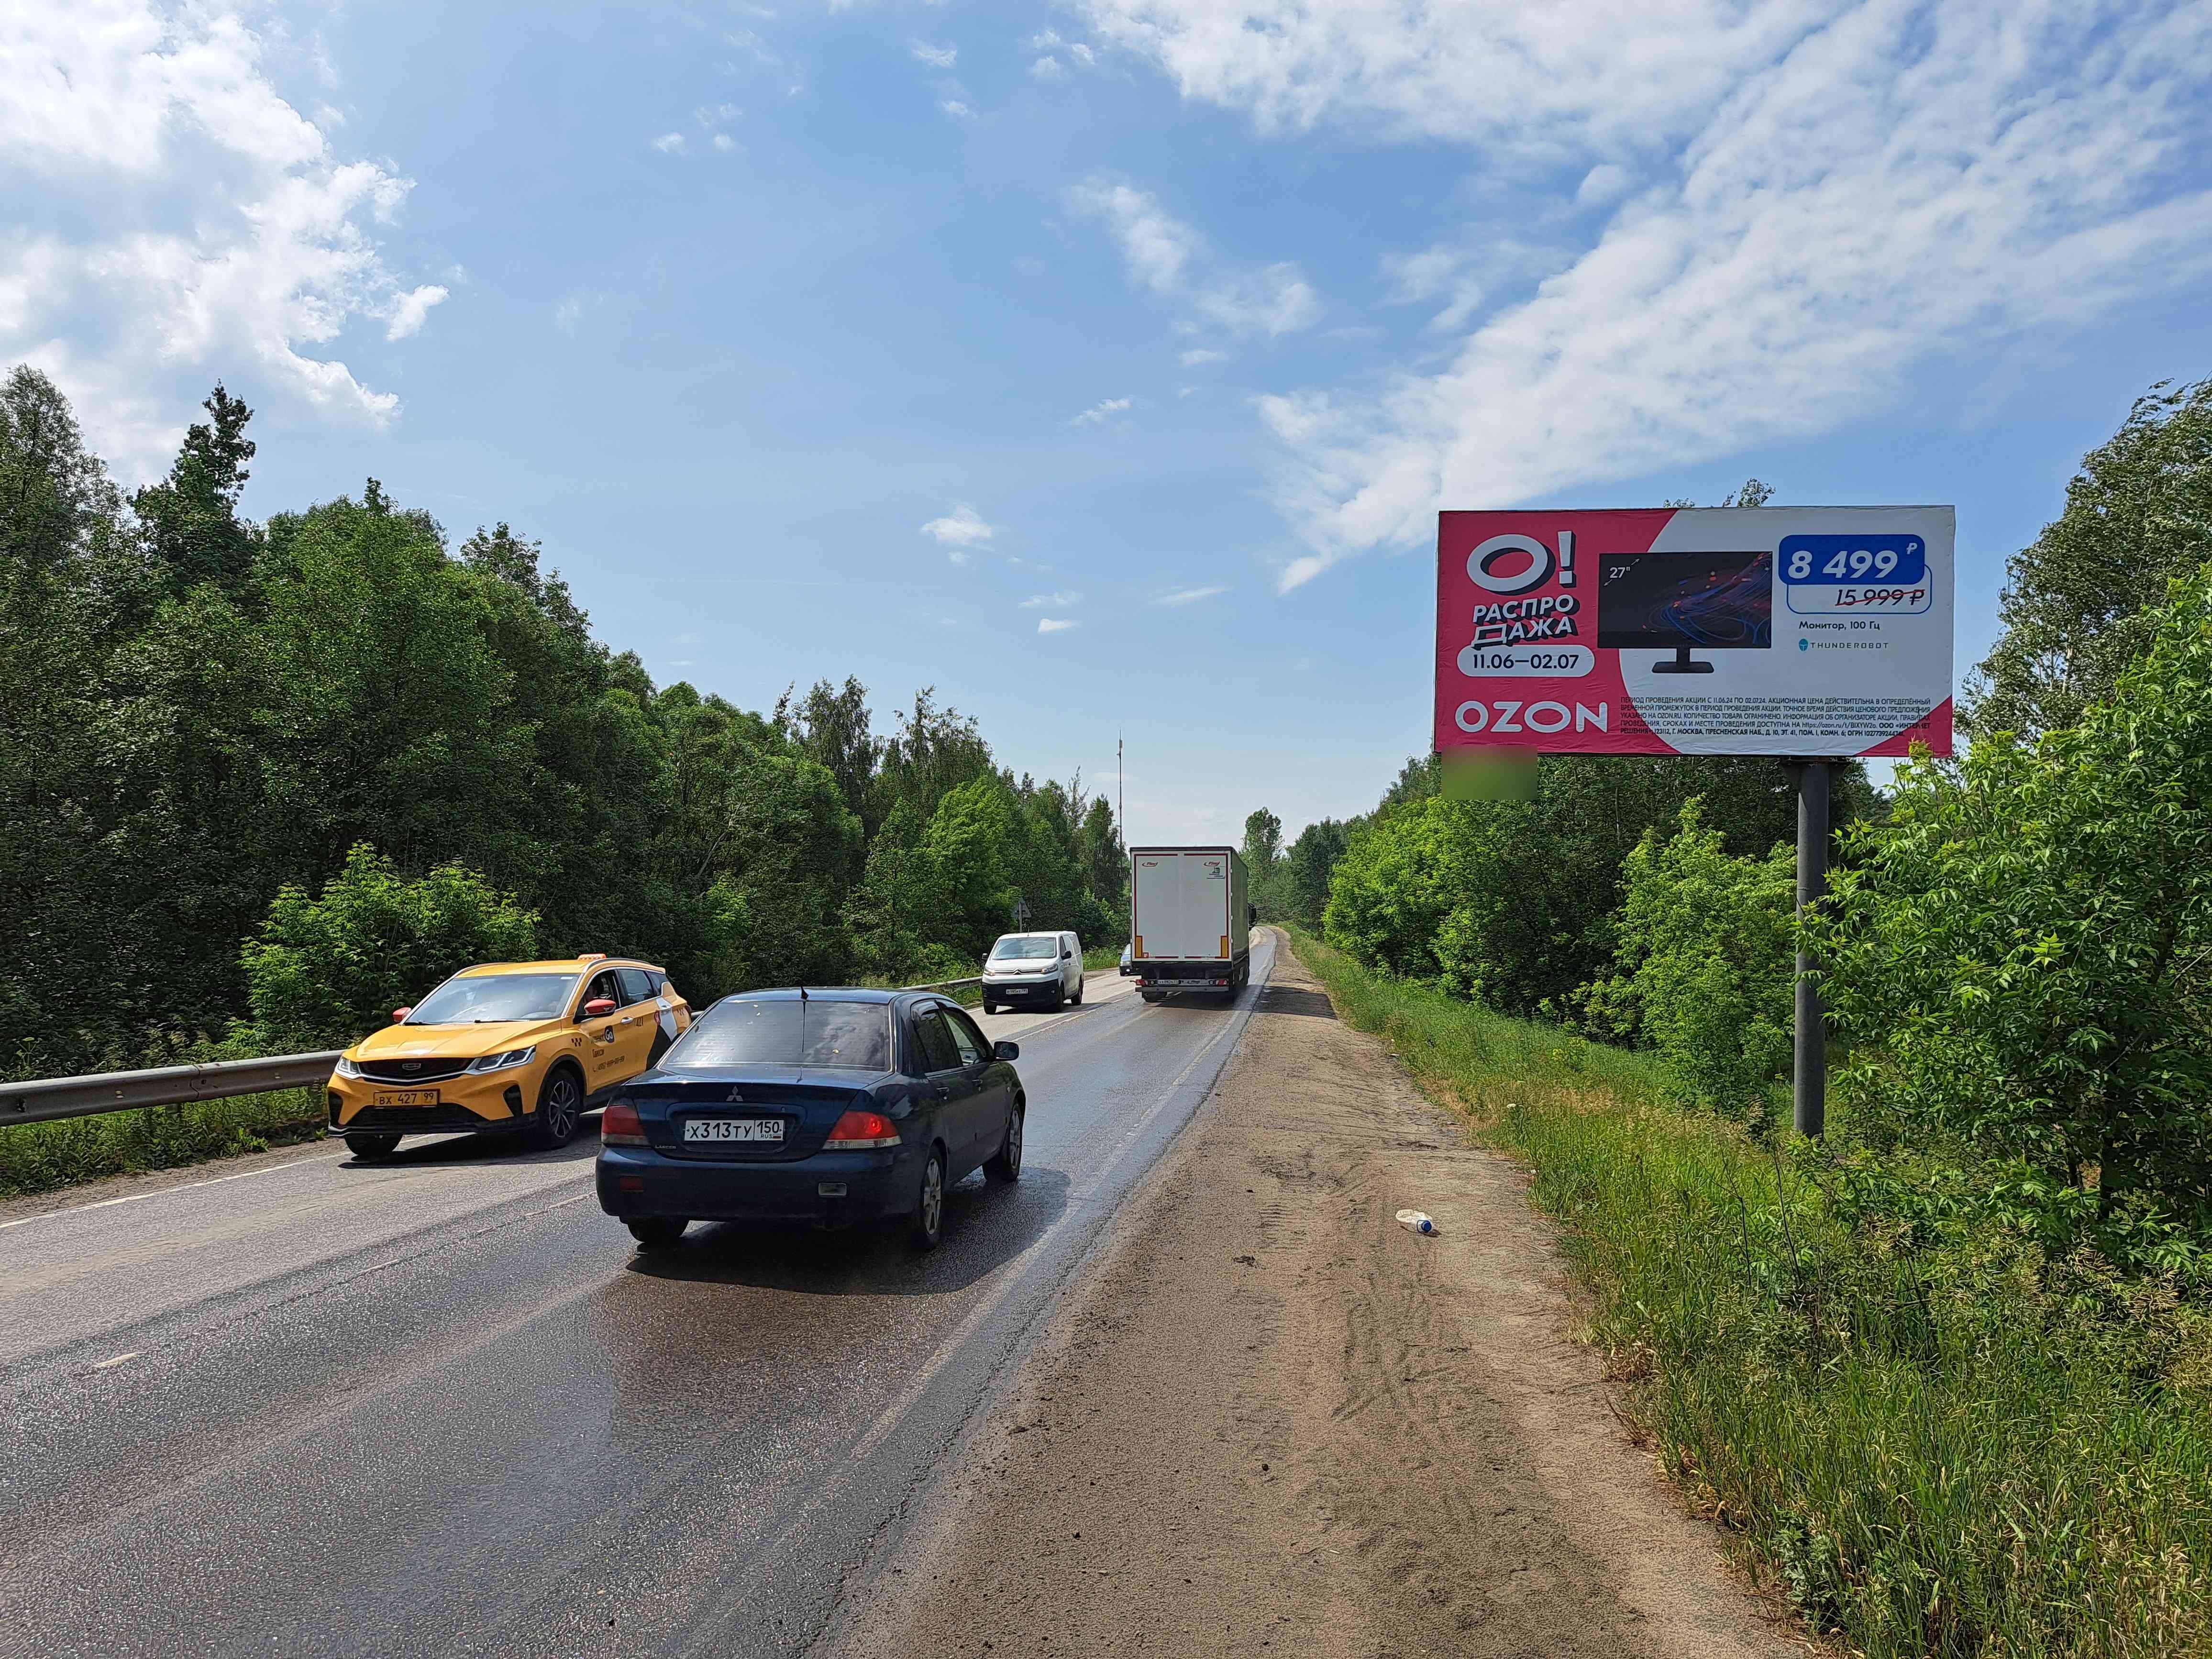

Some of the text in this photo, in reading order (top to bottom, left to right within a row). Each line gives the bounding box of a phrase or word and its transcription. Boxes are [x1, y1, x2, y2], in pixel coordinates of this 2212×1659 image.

[1609, 566, 1630, 578] 27"
[1788, 550, 1813, 579] 8
[1822, 550, 1898, 578] 499
[1837, 589, 1857, 606] 15
[1864, 589, 1904, 606] 999
[1472, 594, 1577, 624] РАСПРО
[1471, 616, 1575, 649] ДАЖА
[1798, 621, 1880, 631] Монитор, 100 Гц
[1455, 700, 1608, 733] OZON
[605, 1029, 613, 1040] Go
[379, 1092, 434, 1105] ВХ 427 99
[689, 1121, 780, 1139] Х313ТУ 150
